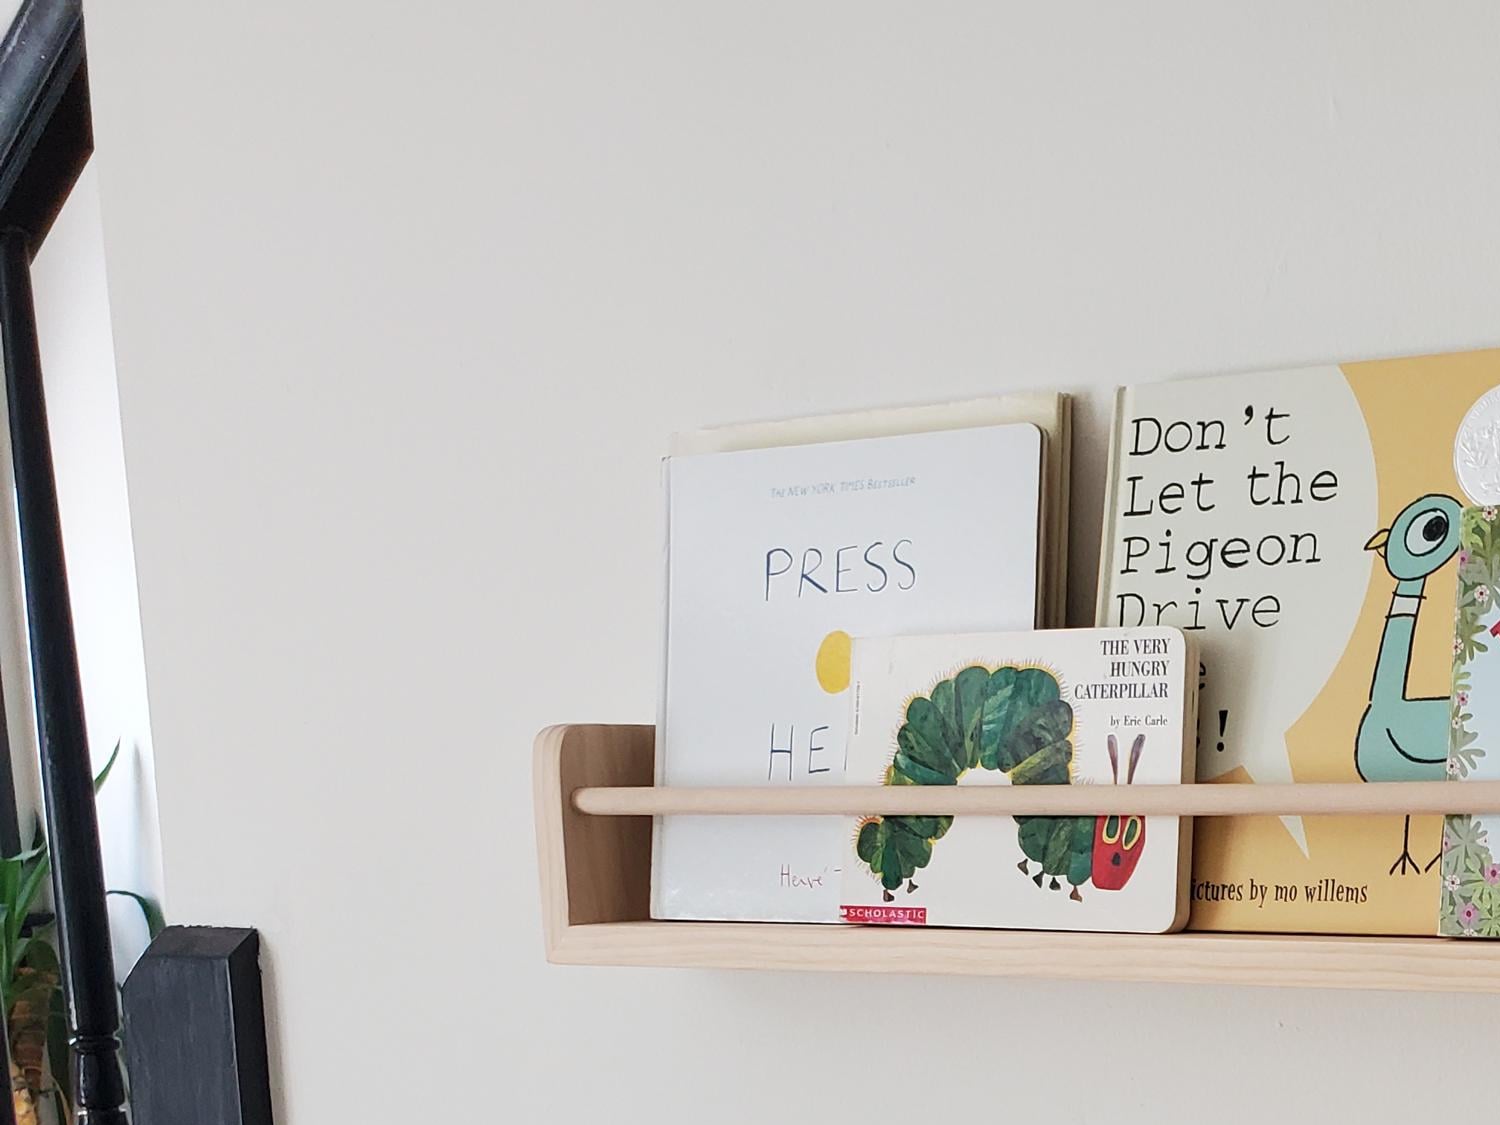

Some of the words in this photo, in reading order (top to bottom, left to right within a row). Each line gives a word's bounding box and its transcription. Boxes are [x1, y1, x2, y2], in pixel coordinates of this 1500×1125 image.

[1128, 405, 1291, 456] Don't
[1123, 473, 1215, 517] Let
[1247, 461, 1340, 505] the
[764, 538, 917, 602] PRESS
[1119, 531, 1321, 579] Pigeon
[1116, 588, 1281, 631] Drive
[1100, 639, 1130, 656] THE
[1133, 638, 1170, 654] VERY
[1110, 660, 1170, 677] HUNGRY
[1074, 682, 1168, 700] CATERPILLAR
[1110, 715, 1120, 728] by
[1124, 715, 1142, 727] Eric
[1145, 715, 1168, 726] Carle
[768, 722, 847, 781] HE
[1250, 878, 1268, 908] by
[1275, 883, 1298, 902] mo
[1304, 878, 1368, 904] willems
[849, 908, 925, 919] SCHOLASTIC
